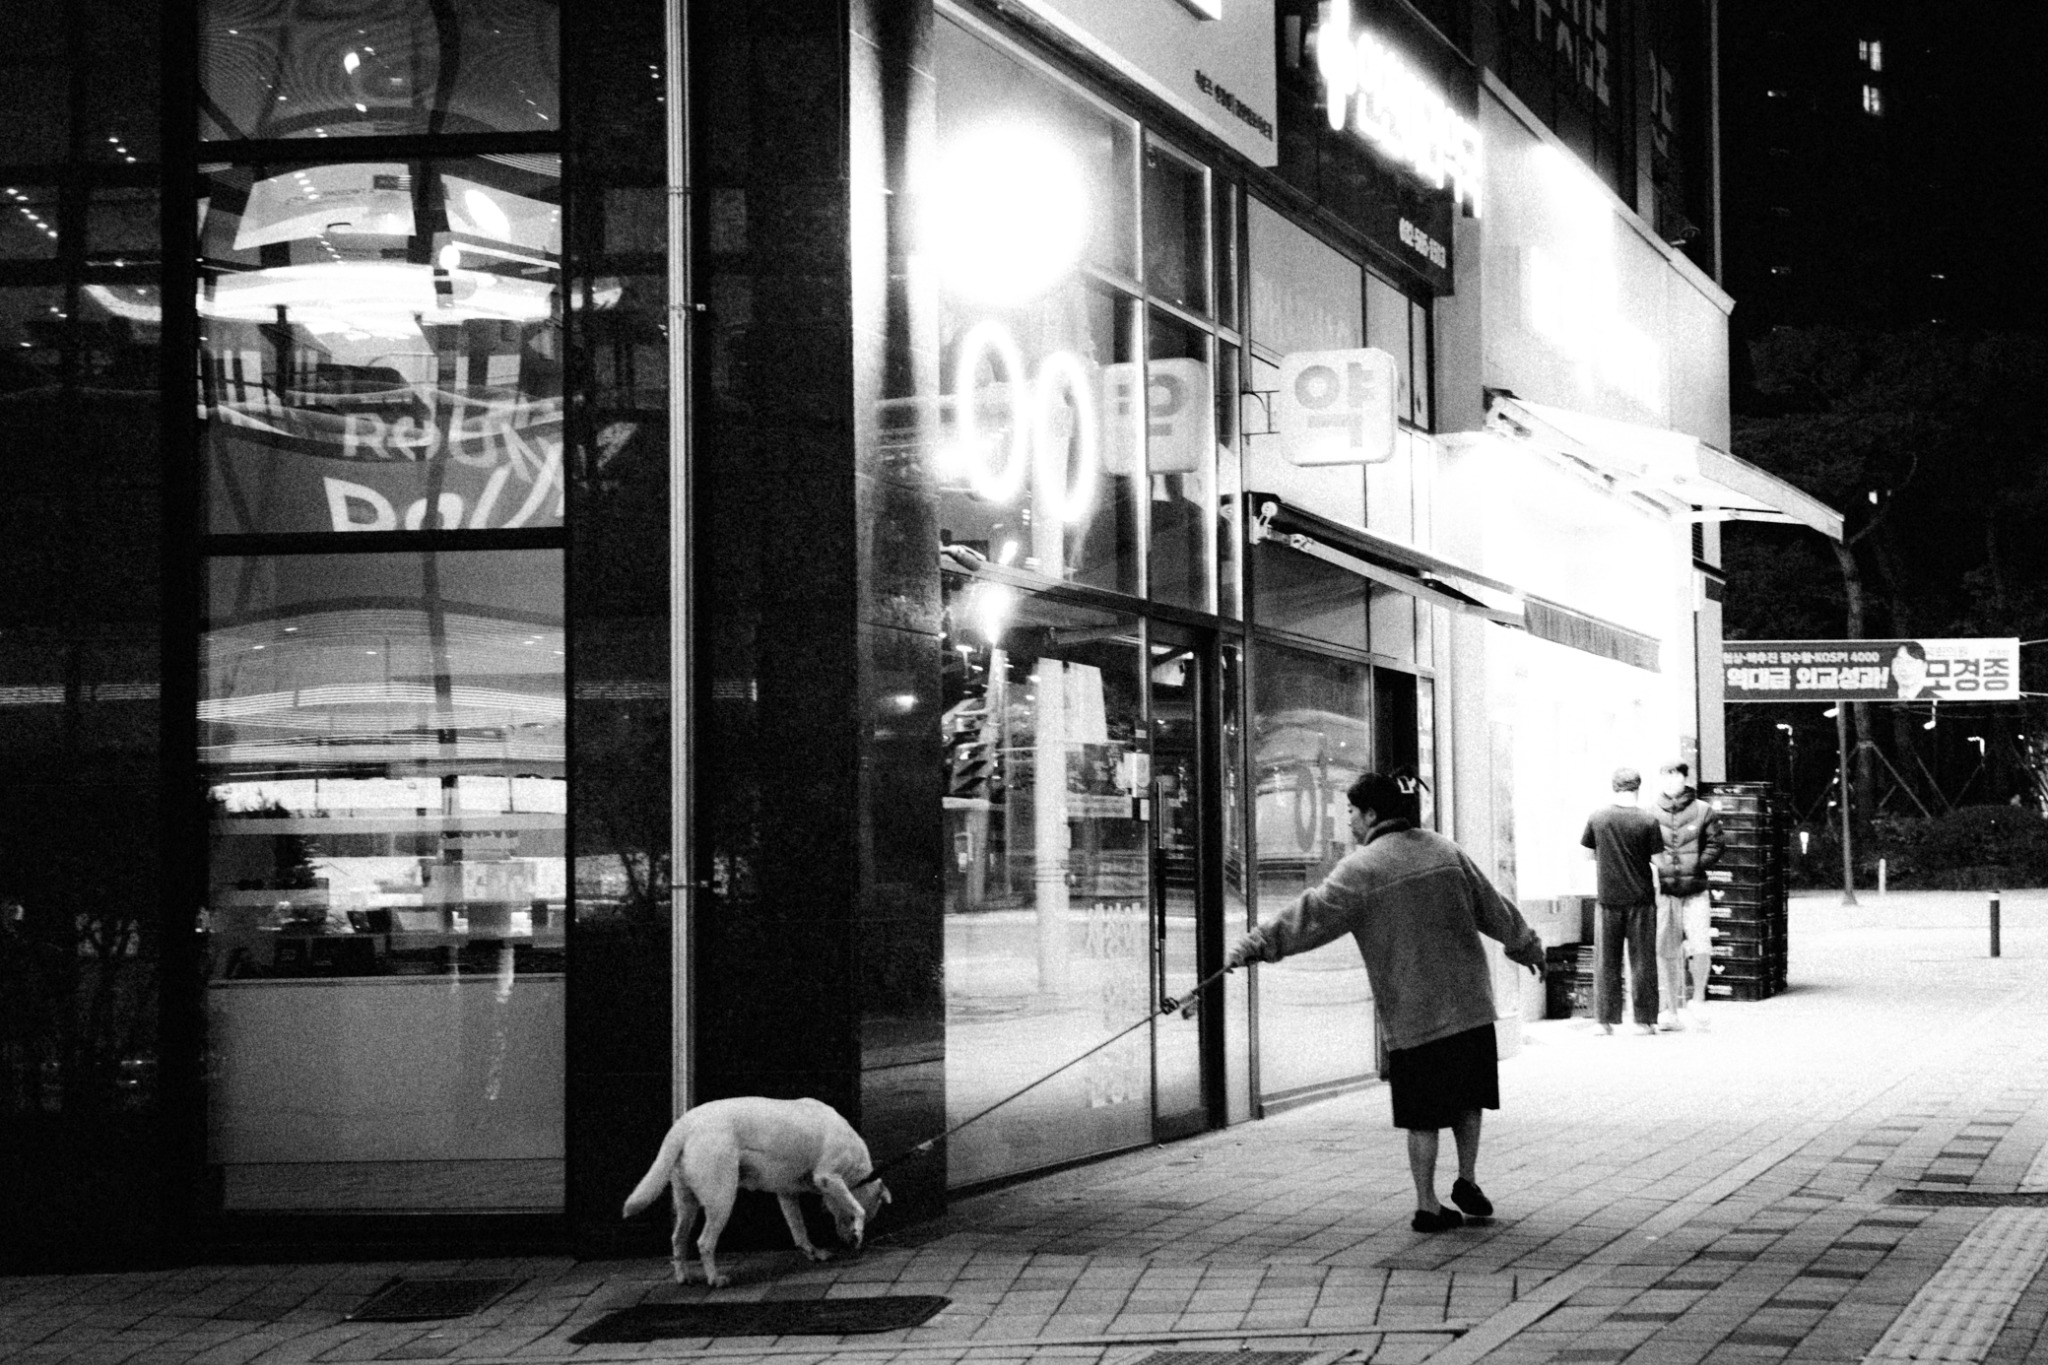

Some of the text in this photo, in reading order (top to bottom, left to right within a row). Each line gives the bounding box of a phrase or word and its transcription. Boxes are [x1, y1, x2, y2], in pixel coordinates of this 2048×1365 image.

[1294, 361, 1376, 449] 약
[1850, 651, 1879, 663] 4000
[1726, 667, 1889, 689] 역대급 외교성과!
[1925, 658, 2010, 691] 모경종
